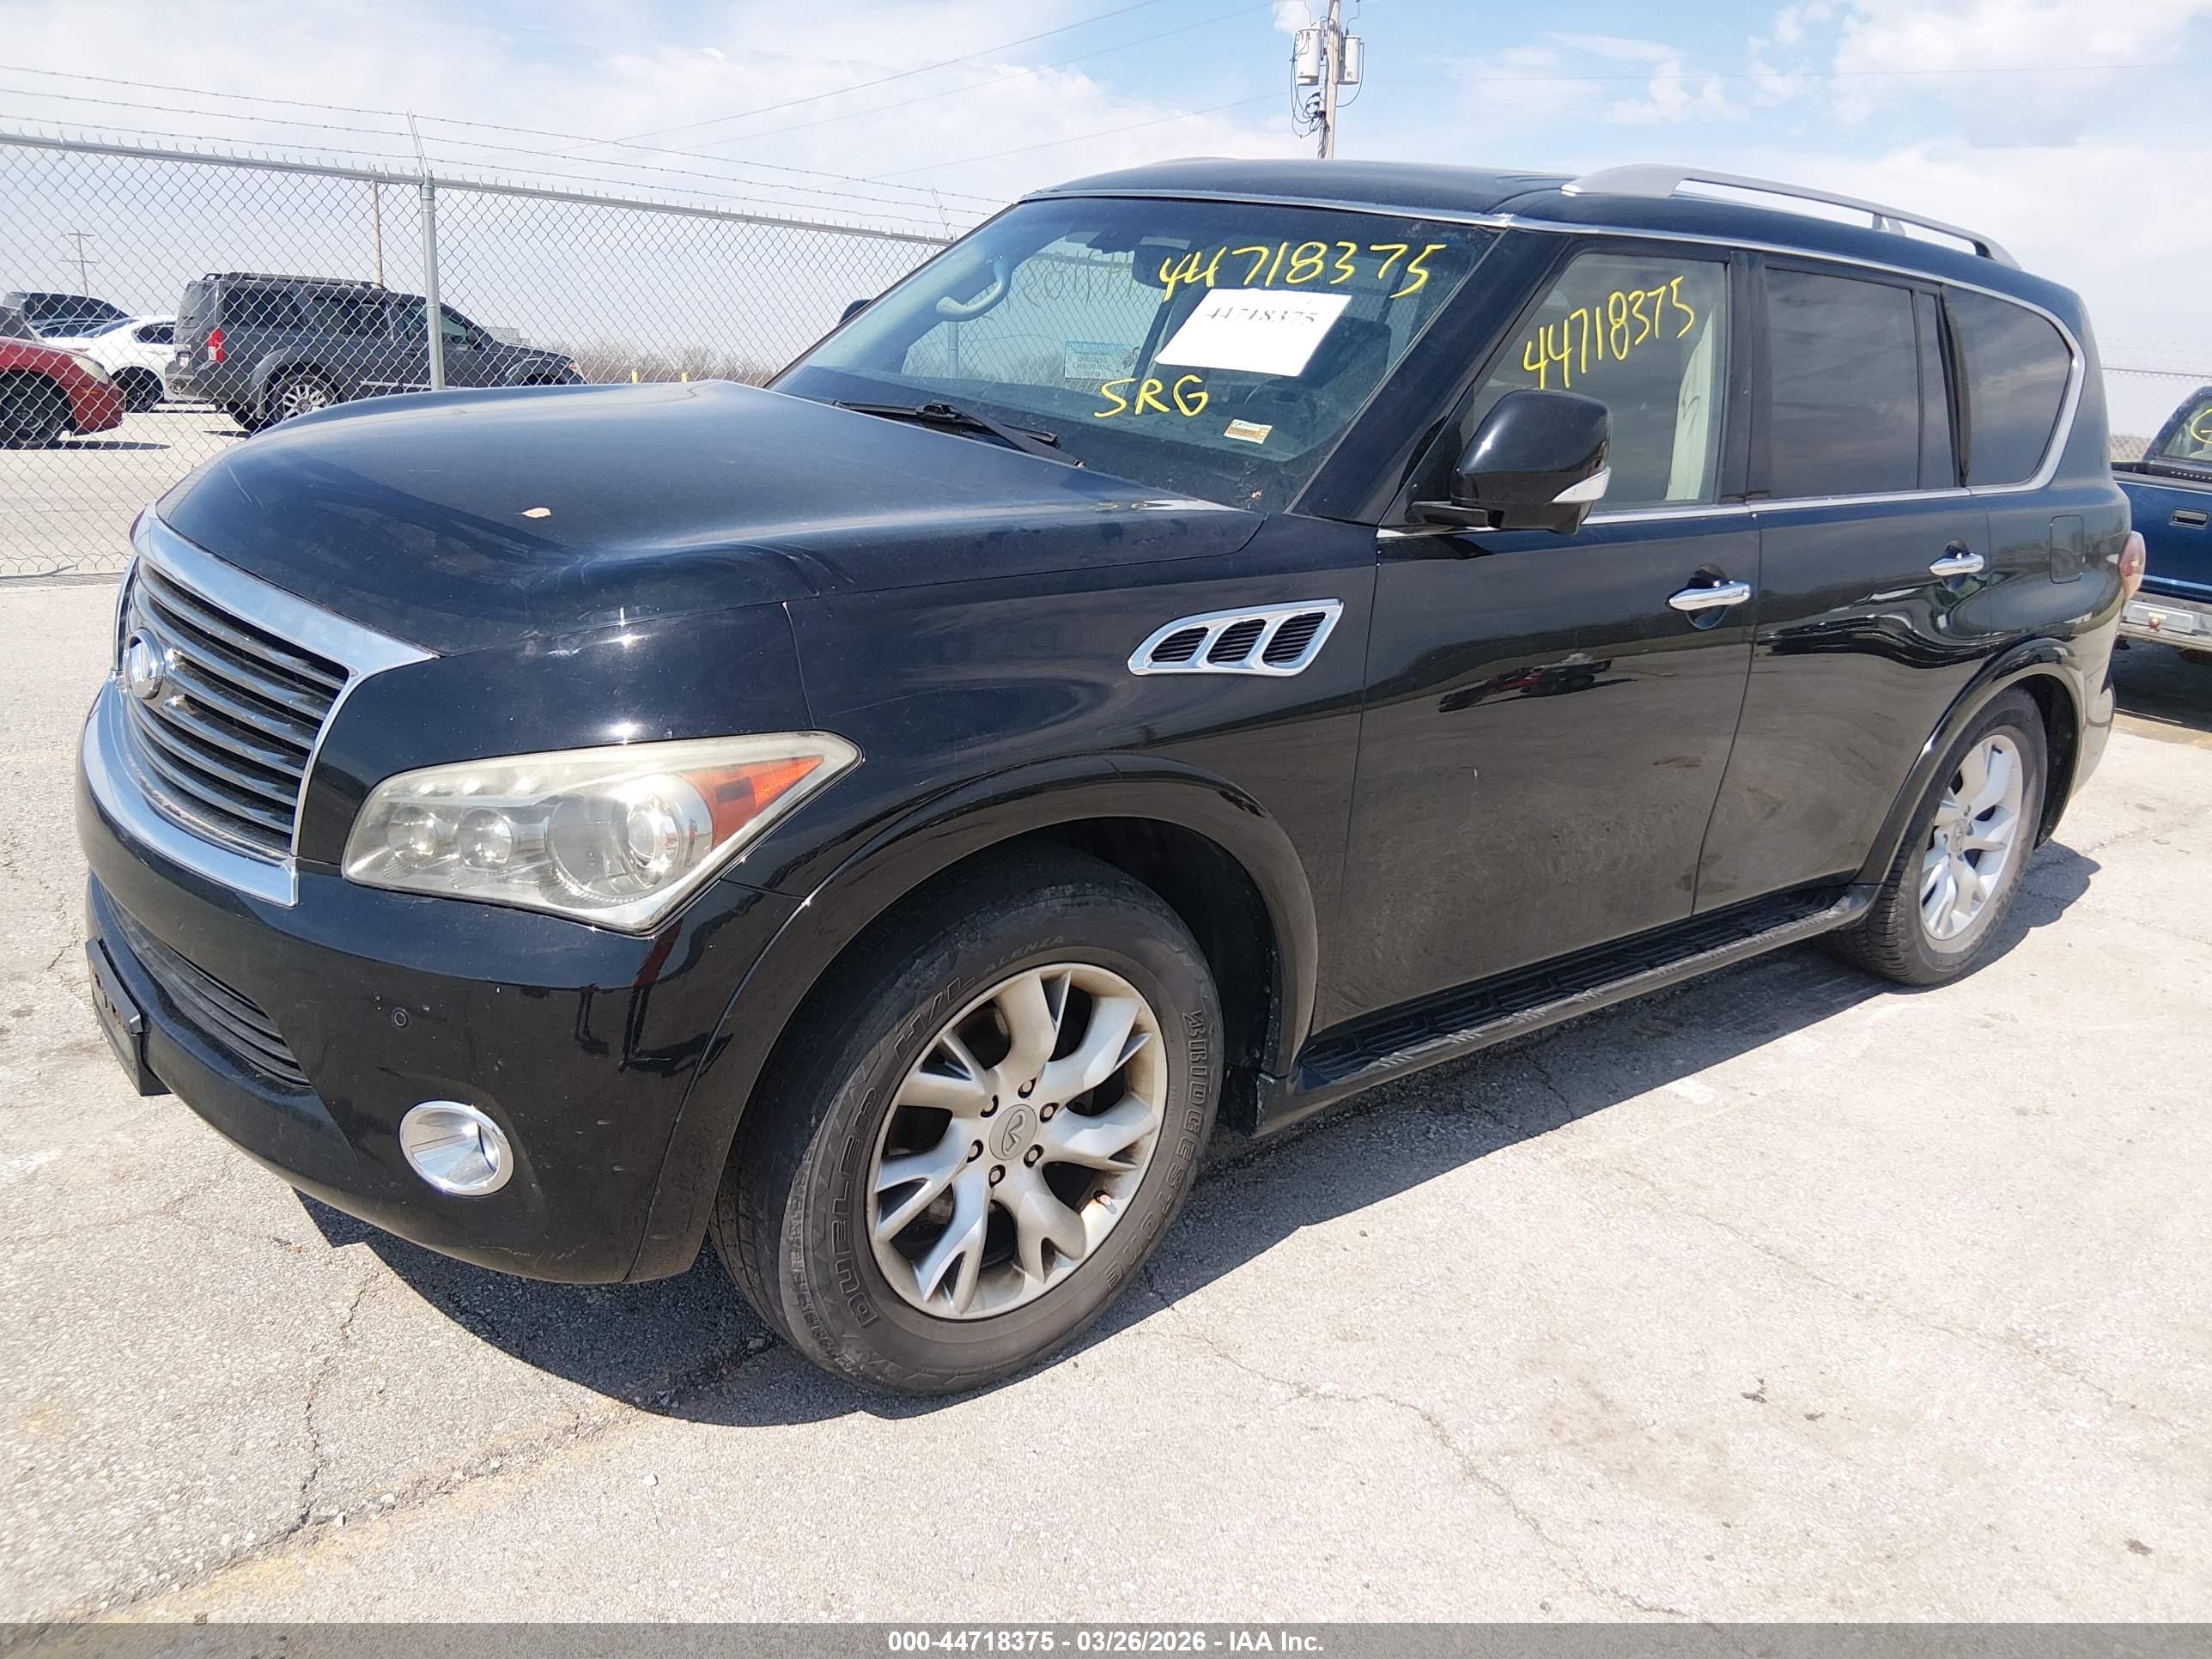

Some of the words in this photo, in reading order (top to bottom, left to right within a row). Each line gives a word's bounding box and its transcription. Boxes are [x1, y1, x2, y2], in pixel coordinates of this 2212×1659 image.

[1158, 240, 1448, 302] 44718375
[1206, 306, 1320, 324] 44718375
[1522, 276, 1696, 390] 44718375
[1093, 374, 1209, 418] SRG
[830, 1086, 879, 1328] DUELER
[982, 934, 1066, 975] ALENZA
[1105, 1009, 1208, 1290] BRIDGESTONE
